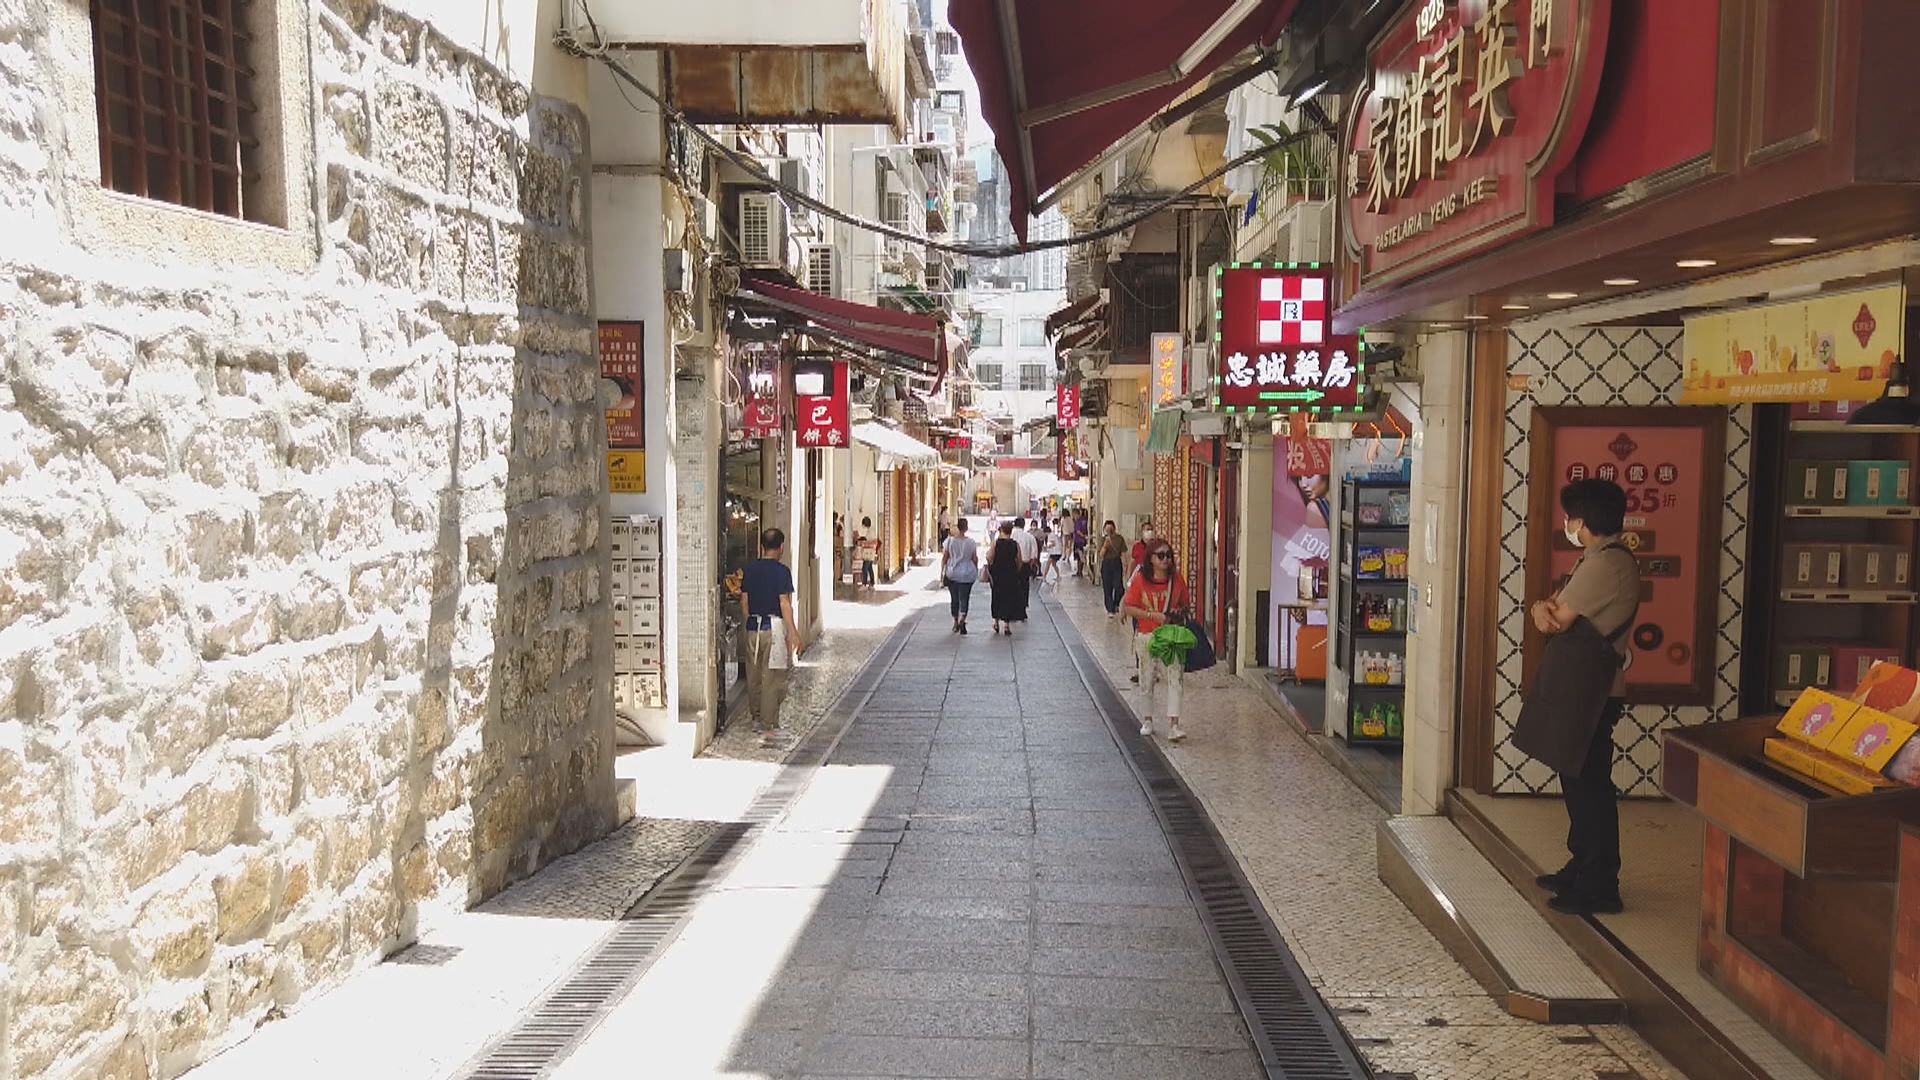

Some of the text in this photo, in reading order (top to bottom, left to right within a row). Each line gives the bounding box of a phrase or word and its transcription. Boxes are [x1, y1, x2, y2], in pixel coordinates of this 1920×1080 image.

[1375, 176, 1485, 252] PASTELARIA YENG KEE
[1225, 350, 1356, 388] 忠誠藥房
[802, 428, 843, 446] 餅家
[1570, 465, 1674, 482] 月餅優惠
